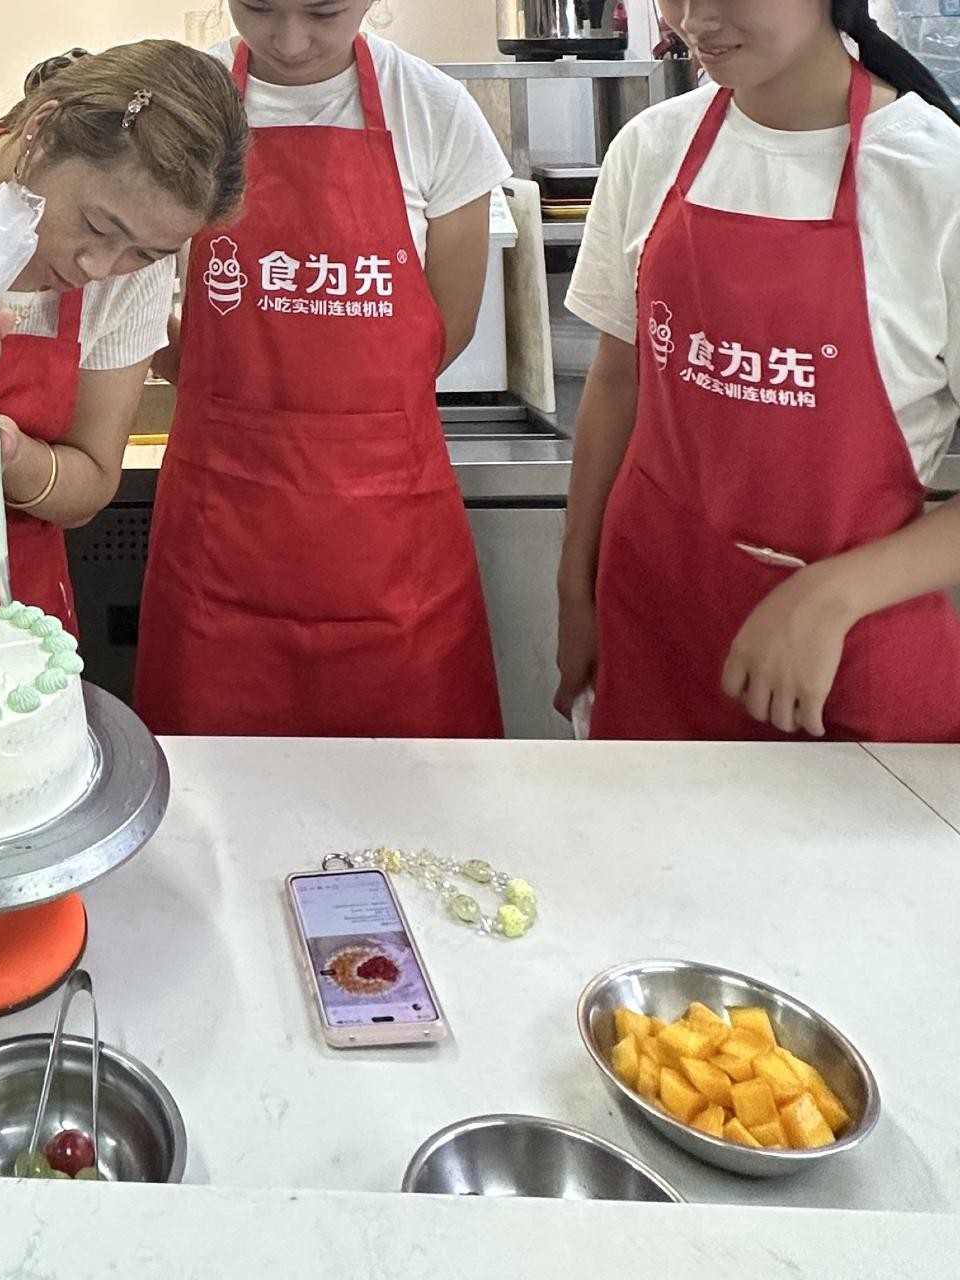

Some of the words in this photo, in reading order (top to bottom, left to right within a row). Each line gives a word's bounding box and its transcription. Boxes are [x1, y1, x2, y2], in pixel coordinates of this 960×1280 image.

[258, 251, 393, 296] 食为先
[257, 295, 393, 317] 小吃实训连锁机构
[690, 330, 816, 388] 食为先
[680, 368, 816, 408] 小吃实训连锁机构
